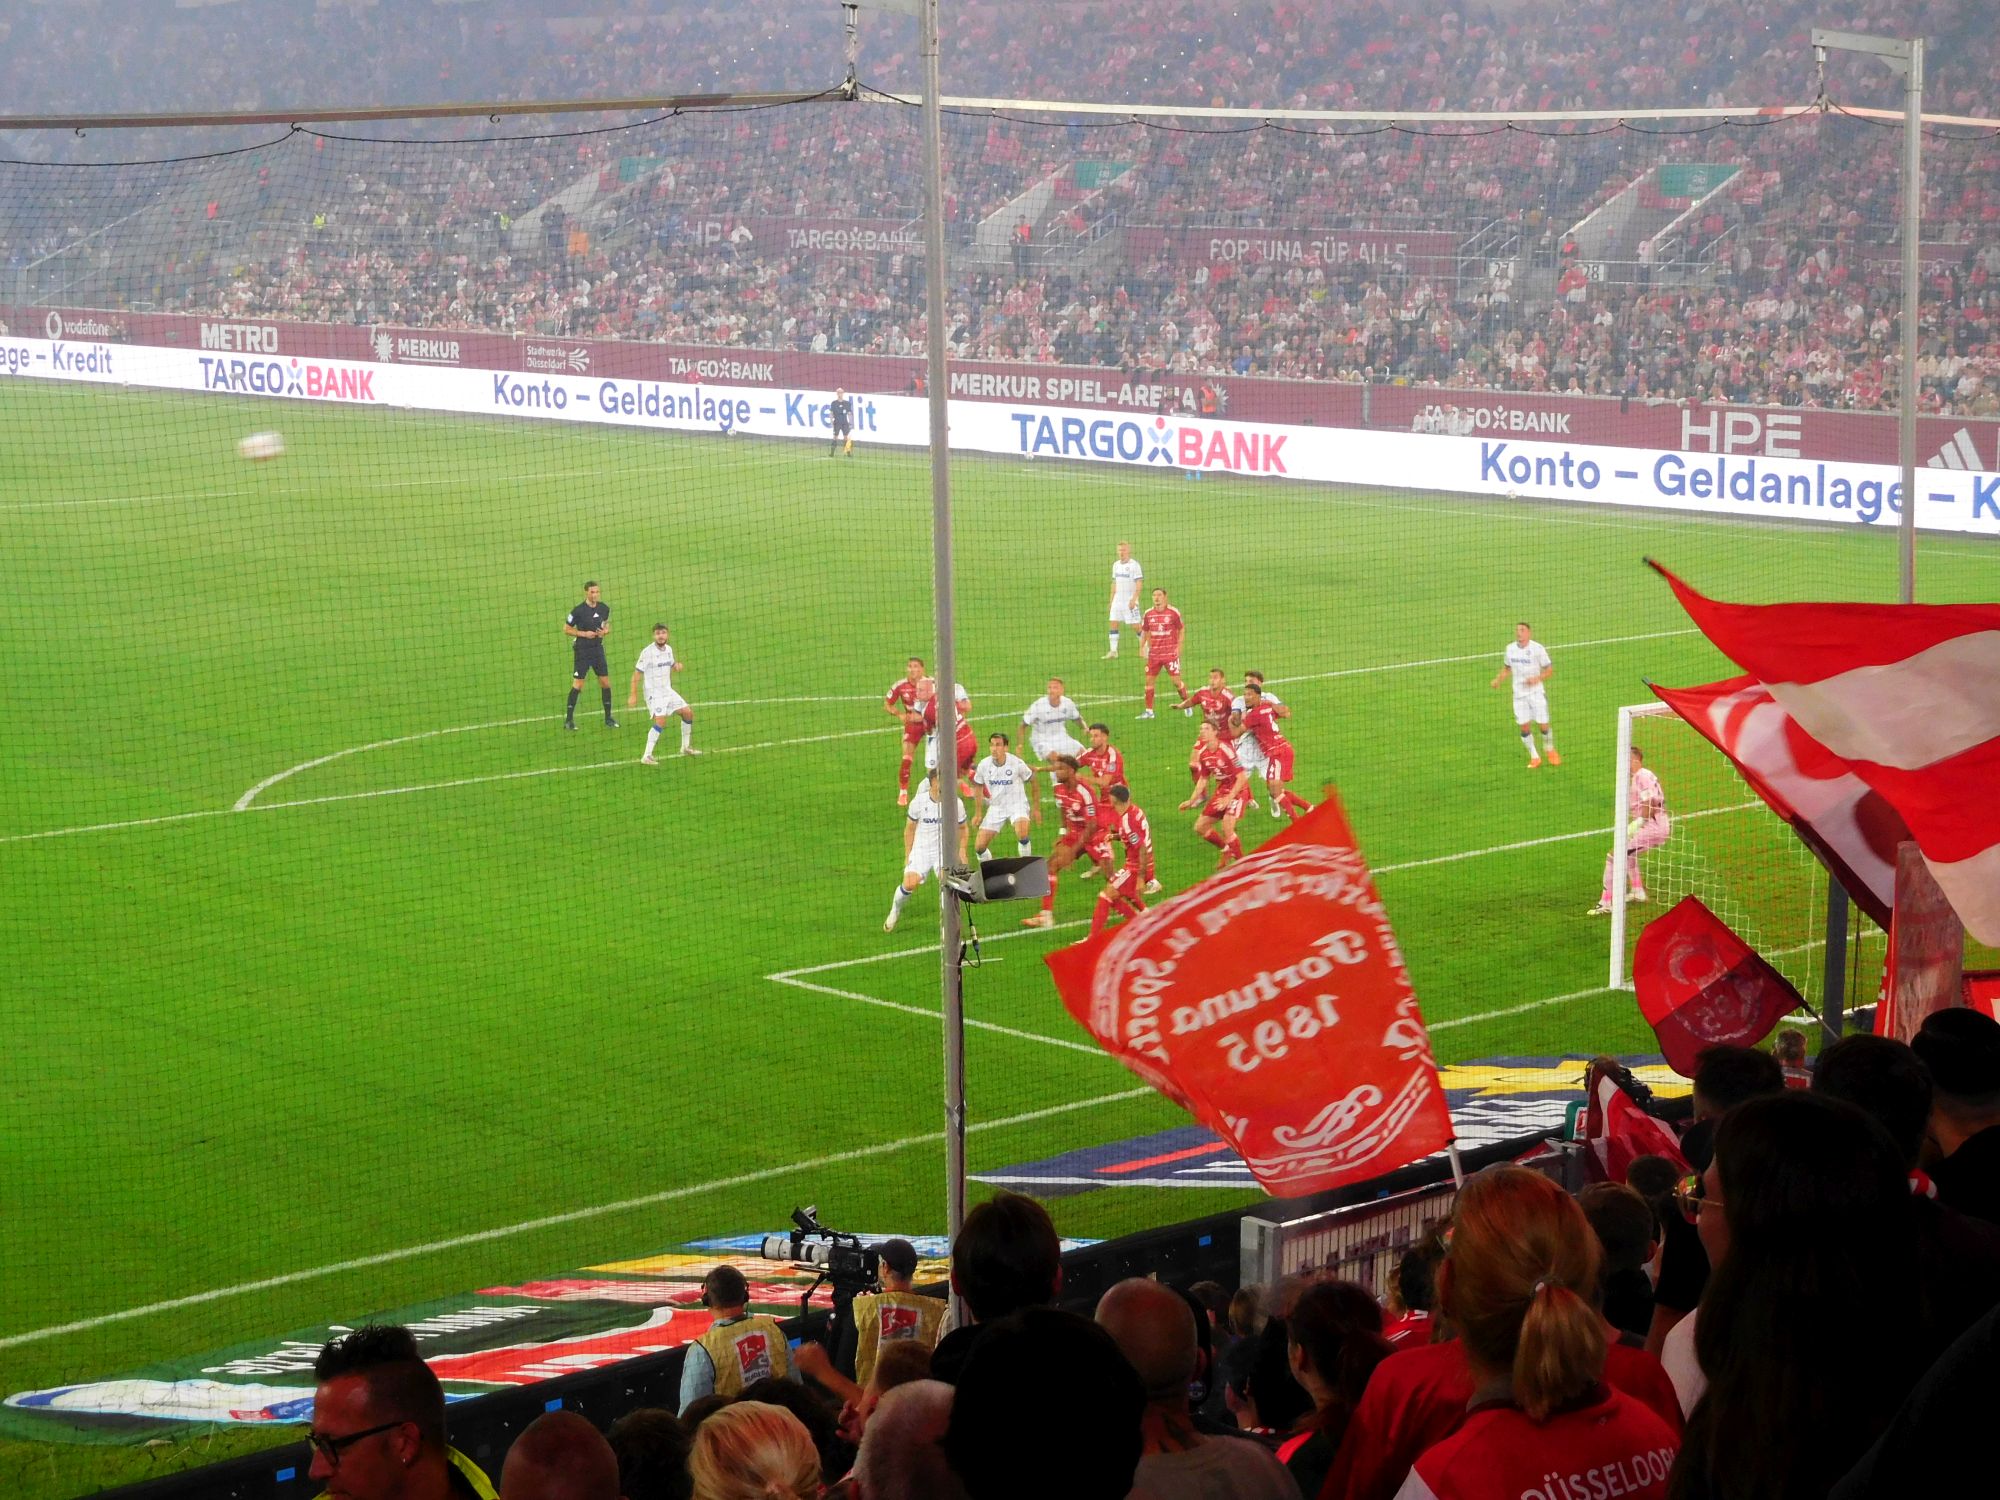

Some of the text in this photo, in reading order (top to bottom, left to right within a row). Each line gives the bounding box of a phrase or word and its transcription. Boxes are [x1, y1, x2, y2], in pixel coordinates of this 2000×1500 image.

[53, 342, 113, 374] Kredit
[200, 322, 278, 354] METRO
[398, 338, 460, 359] MERKUR
[493, 373, 568, 410] Konto
[599, 380, 751, 433] Geldanlage
[950, 372, 1041, 399] MERKUR
[1681, 408, 1802, 458] HPE
[1480, 441, 1601, 490] Konto
[1653, 453, 1903, 524] Geldanlage
[1520, 1447, 1676, 1500] ÜSSELDOR
